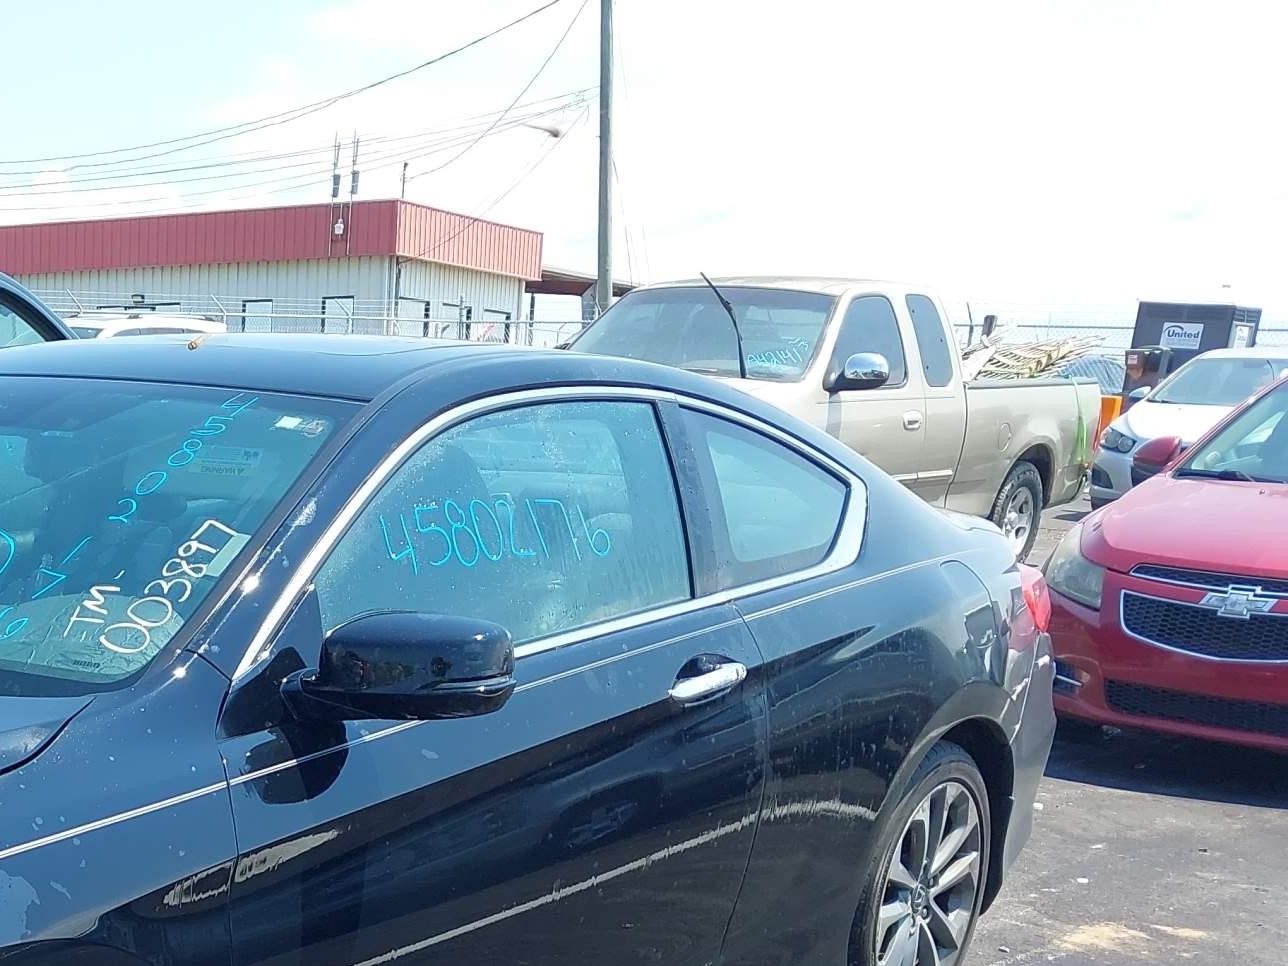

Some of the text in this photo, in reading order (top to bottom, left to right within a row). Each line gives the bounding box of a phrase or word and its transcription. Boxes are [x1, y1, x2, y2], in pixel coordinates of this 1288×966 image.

[1167, 329, 1200, 339] United
[379, 498, 612, 576] 45802176
[99, 519, 239, 654] 003897
